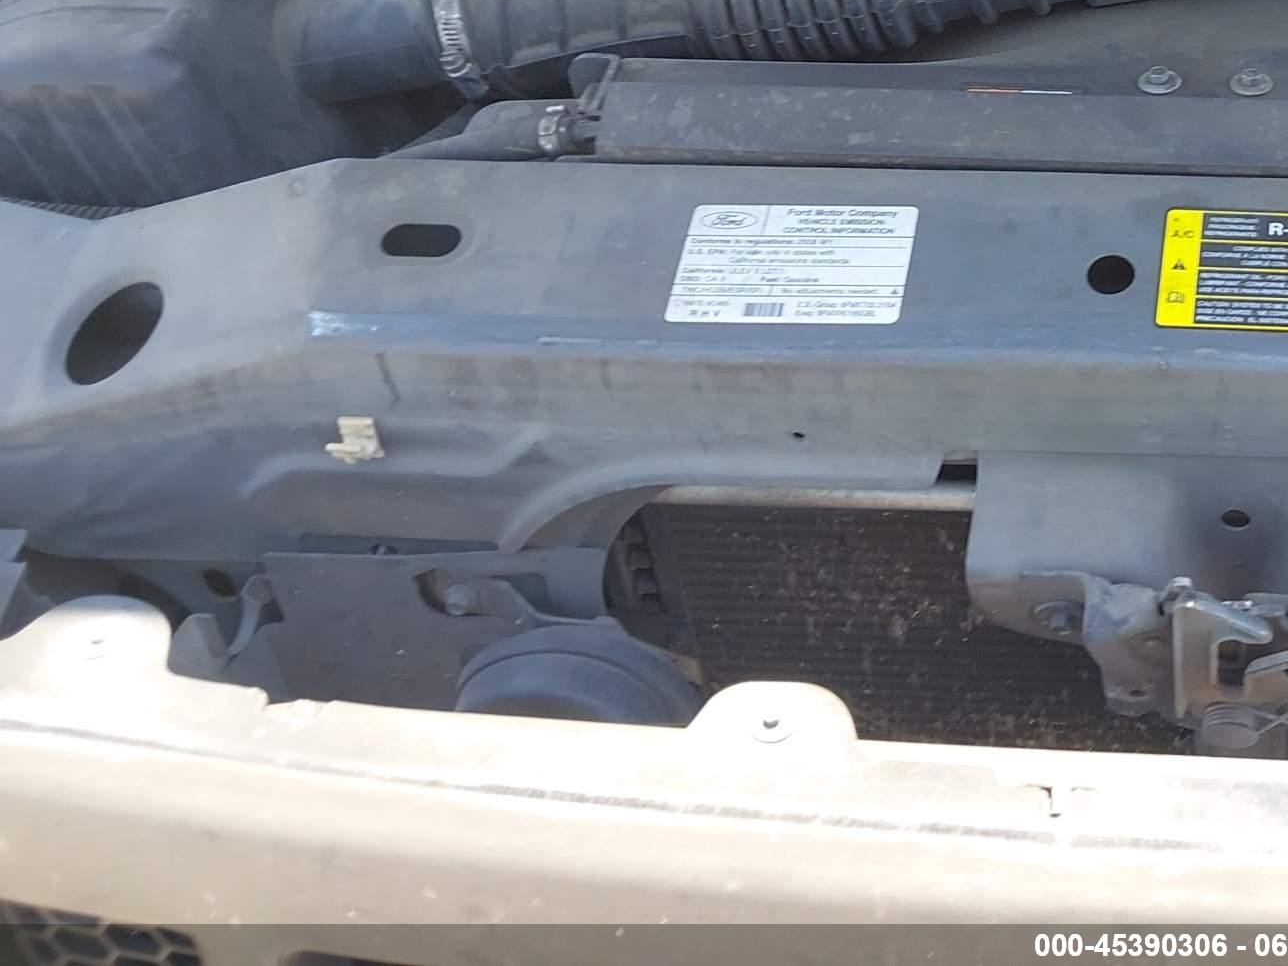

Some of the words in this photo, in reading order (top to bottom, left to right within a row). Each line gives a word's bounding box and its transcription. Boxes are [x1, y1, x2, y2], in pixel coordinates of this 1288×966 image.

[787, 208, 812, 217] Ford
[815, 209, 845, 217] Motor
[851, 209, 898, 219] Company
[712, 214, 745, 226] Ford
